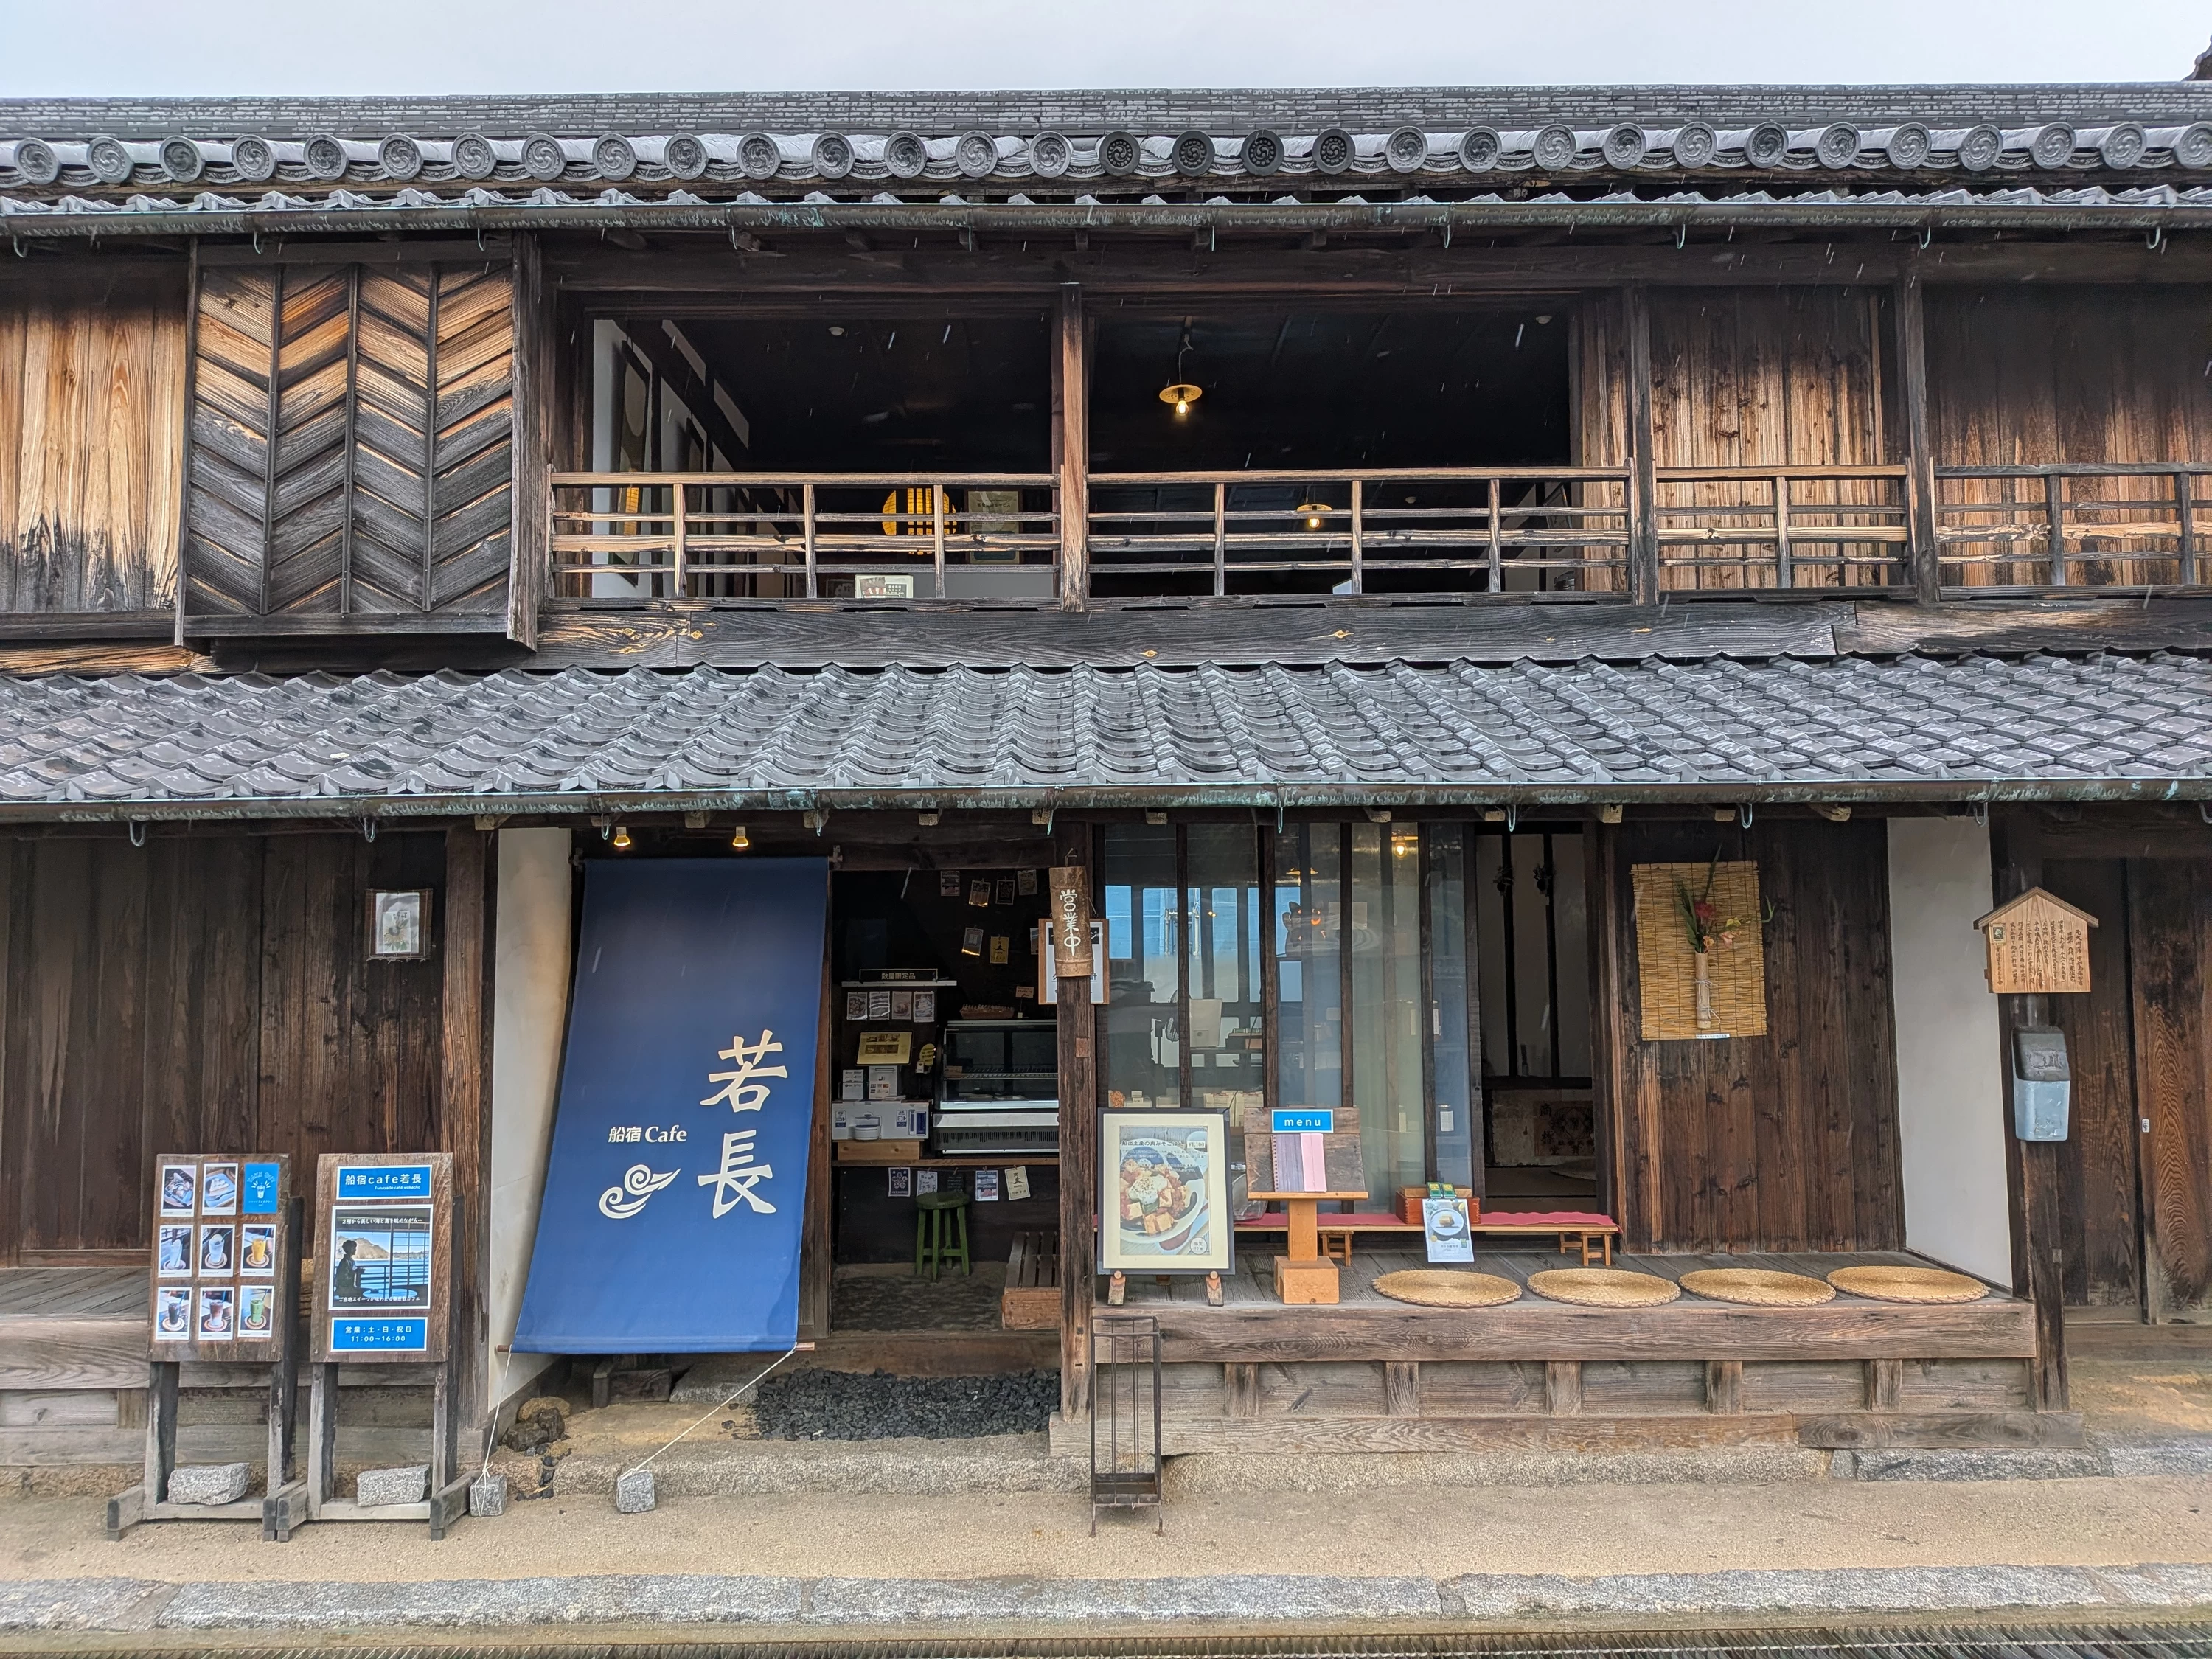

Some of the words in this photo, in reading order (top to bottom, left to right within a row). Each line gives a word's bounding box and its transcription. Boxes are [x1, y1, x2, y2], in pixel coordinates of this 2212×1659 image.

[1060, 888, 1081, 956] 営業中
[698, 1029, 788, 1219] 若長
[1284, 1118, 1321, 1127] menu
[345, 1174, 422, 1186] 船宿cafe若長
